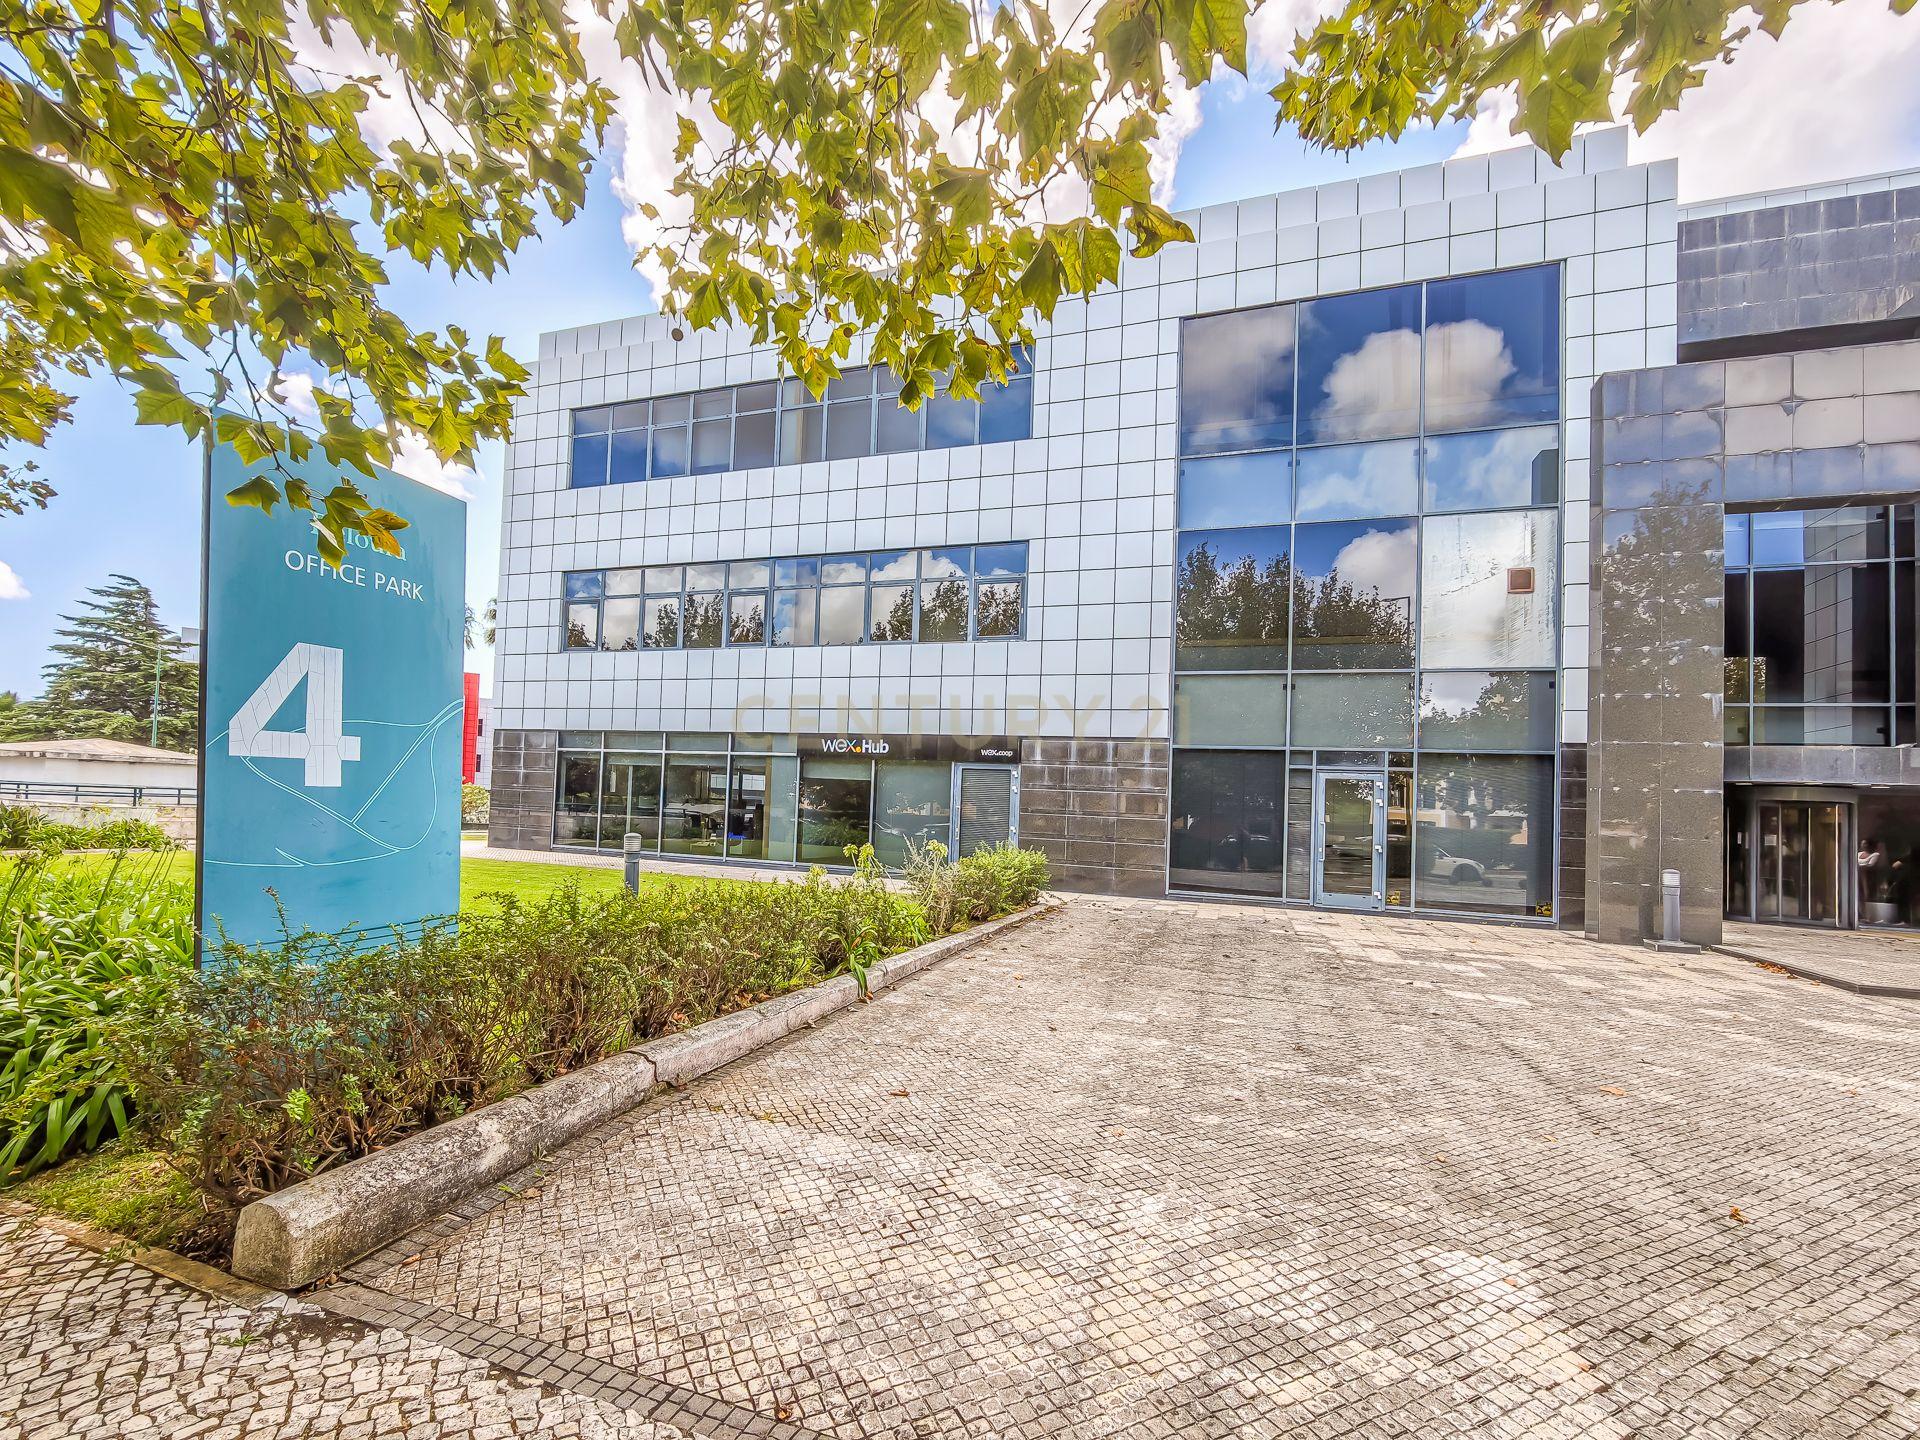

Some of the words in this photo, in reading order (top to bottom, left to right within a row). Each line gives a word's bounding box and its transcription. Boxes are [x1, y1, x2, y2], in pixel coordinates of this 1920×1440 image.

[284, 550, 366, 587] OFFICE
[374, 571, 424, 602] PARK
[228, 642, 361, 787] 4
